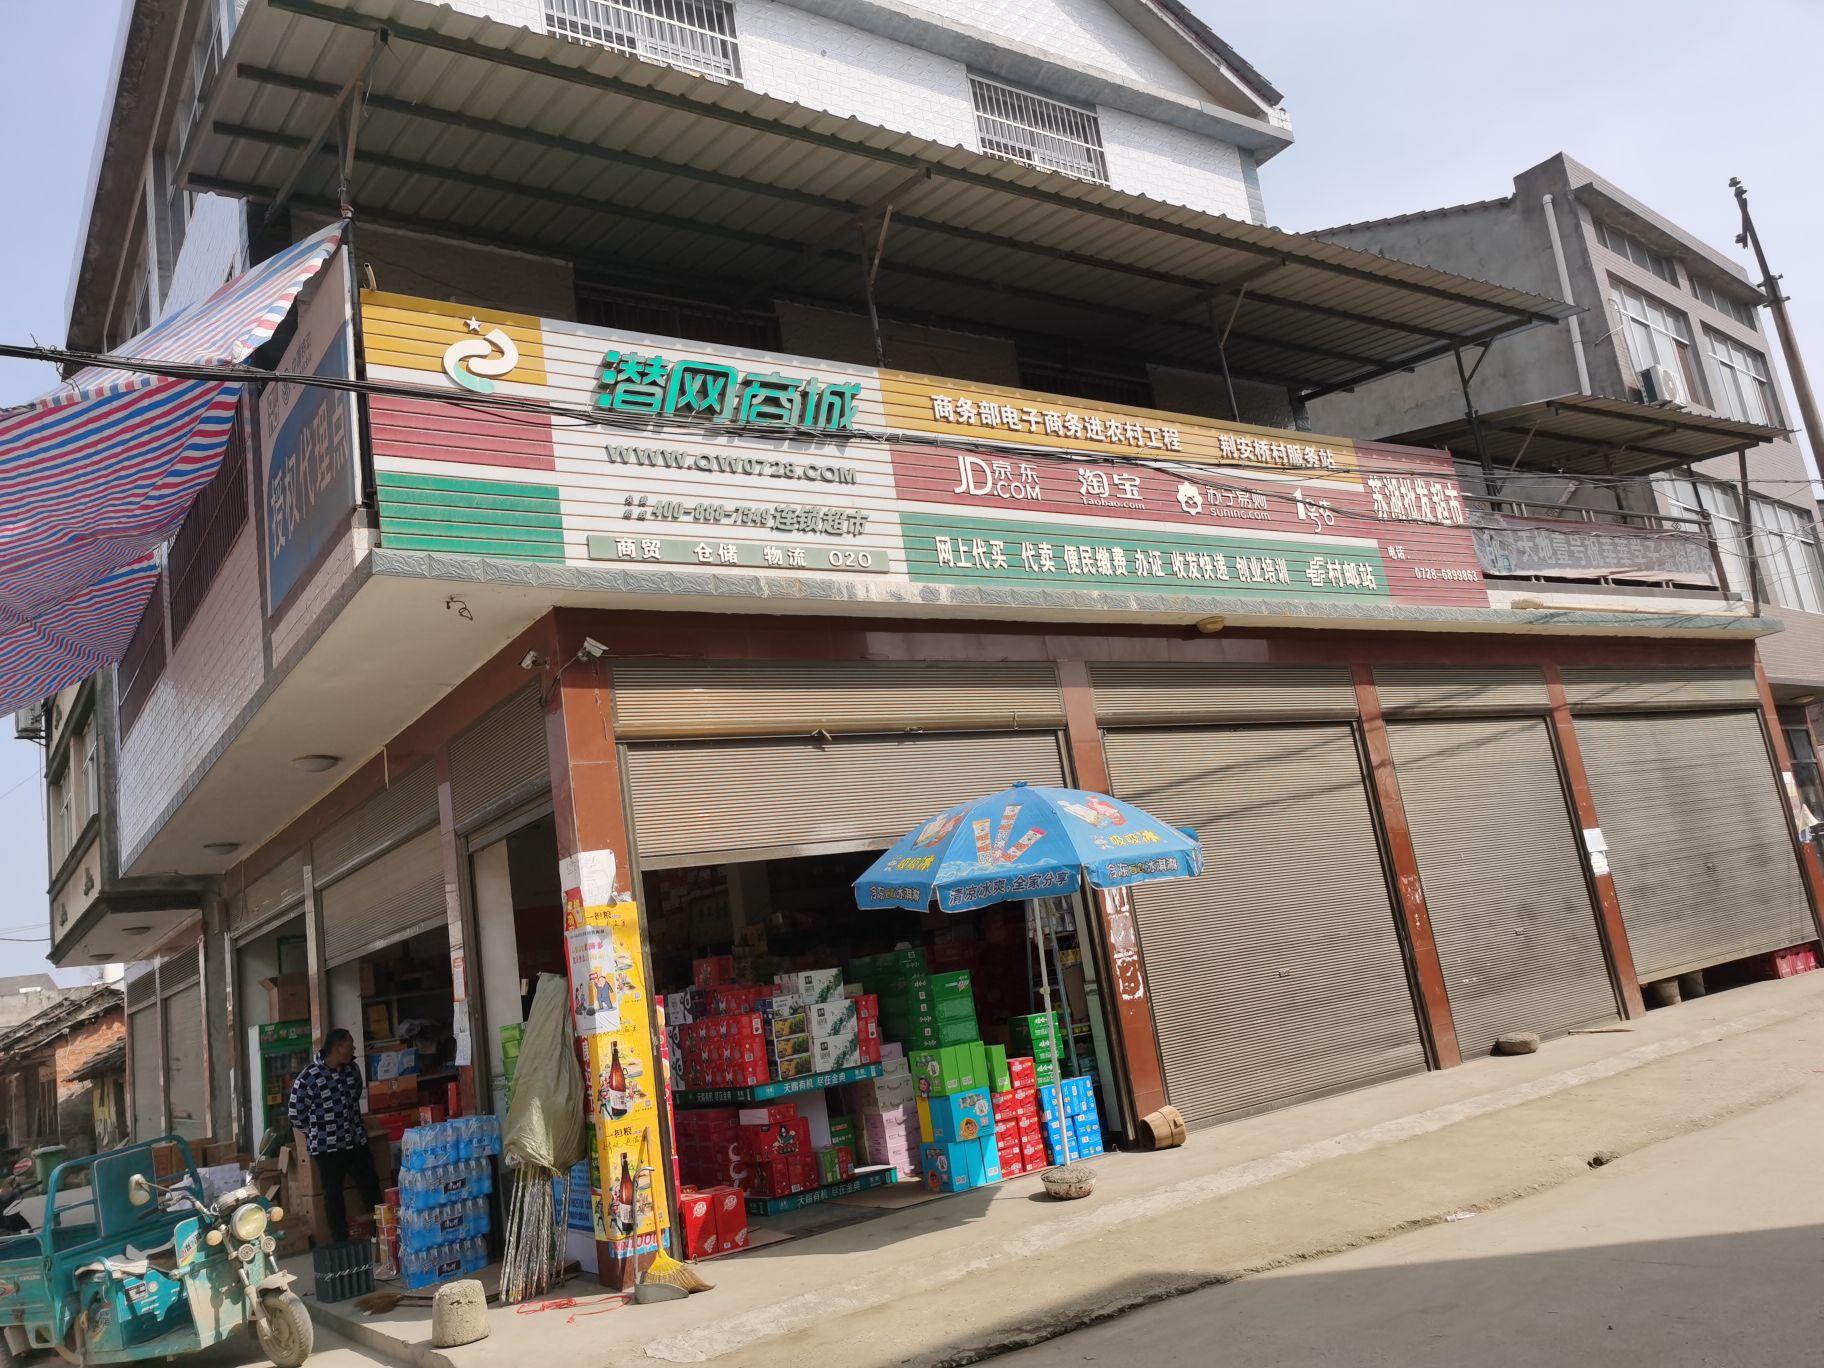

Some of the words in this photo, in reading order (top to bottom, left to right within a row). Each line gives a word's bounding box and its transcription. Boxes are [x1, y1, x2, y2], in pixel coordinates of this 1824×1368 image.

[597, 350, 862, 430] 潜网商城
[930, 394, 1182, 451] 商务部电子商务进农村工程
[605, 444, 857, 484] WWW.QW0728.COM
[1218, 434, 1335, 469] 荆安桥村服务站
[270, 390, 349, 561] 授权代理点
[992, 461, 1040, 483] 京东
[1078, 467, 1143, 500] 淘宝
[651, 500, 770, 525] 400-888-7549
[771, 504, 869, 536] 连锁超市
[1080, 496, 1145, 510] Taobao.com
[615, 538, 661, 560] 商贸
[694, 542, 738, 564] 仓储
[764, 545, 807, 567] 物流
[935, 536, 1008, 569] 网上代买
[1021, 541, 1056, 573] 代卖
[1063, 543, 1128, 577] 便民缴费
[1135, 549, 1165, 577] 办证
[1171, 551, 1230, 581] 收发快递
[1235, 556, 1291, 585] 创业培训
[1414, 567, 1478, 582] 0728-6899863
